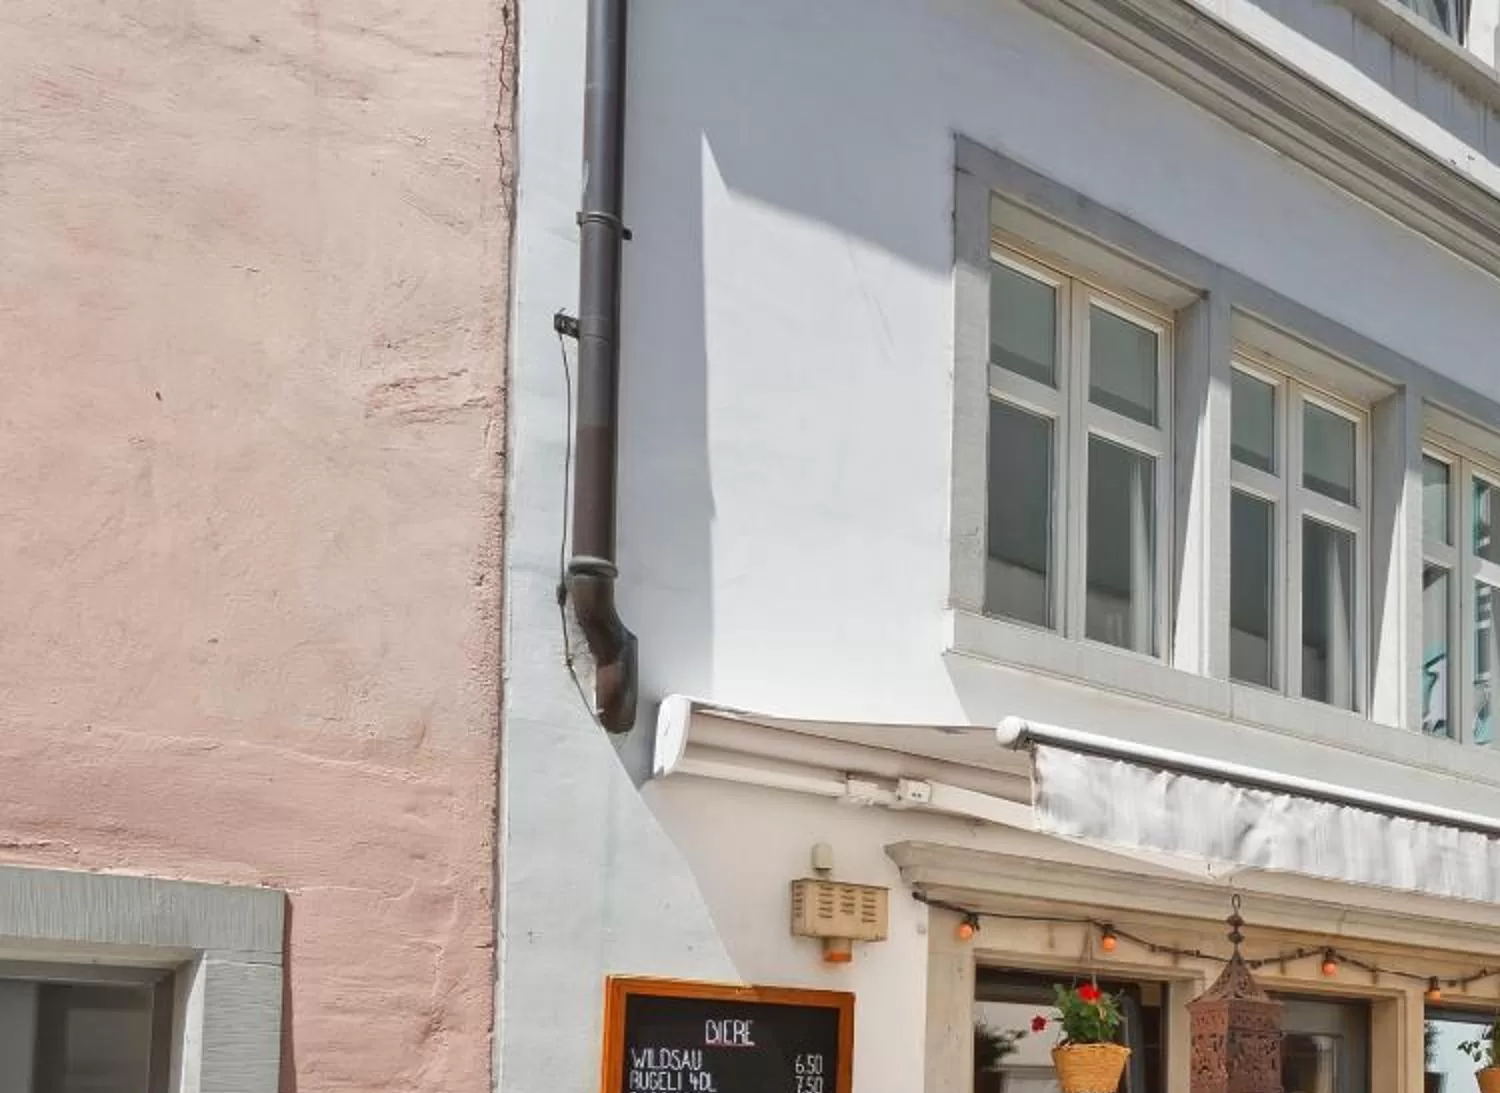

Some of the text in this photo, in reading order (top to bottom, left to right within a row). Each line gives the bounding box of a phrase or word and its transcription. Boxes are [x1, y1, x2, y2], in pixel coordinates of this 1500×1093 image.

[705, 1019, 755, 1046] BIERE
[630, 1047, 823, 1074] WILDSAU 6.50
[795, 1075, 824, 1093] 7.50
